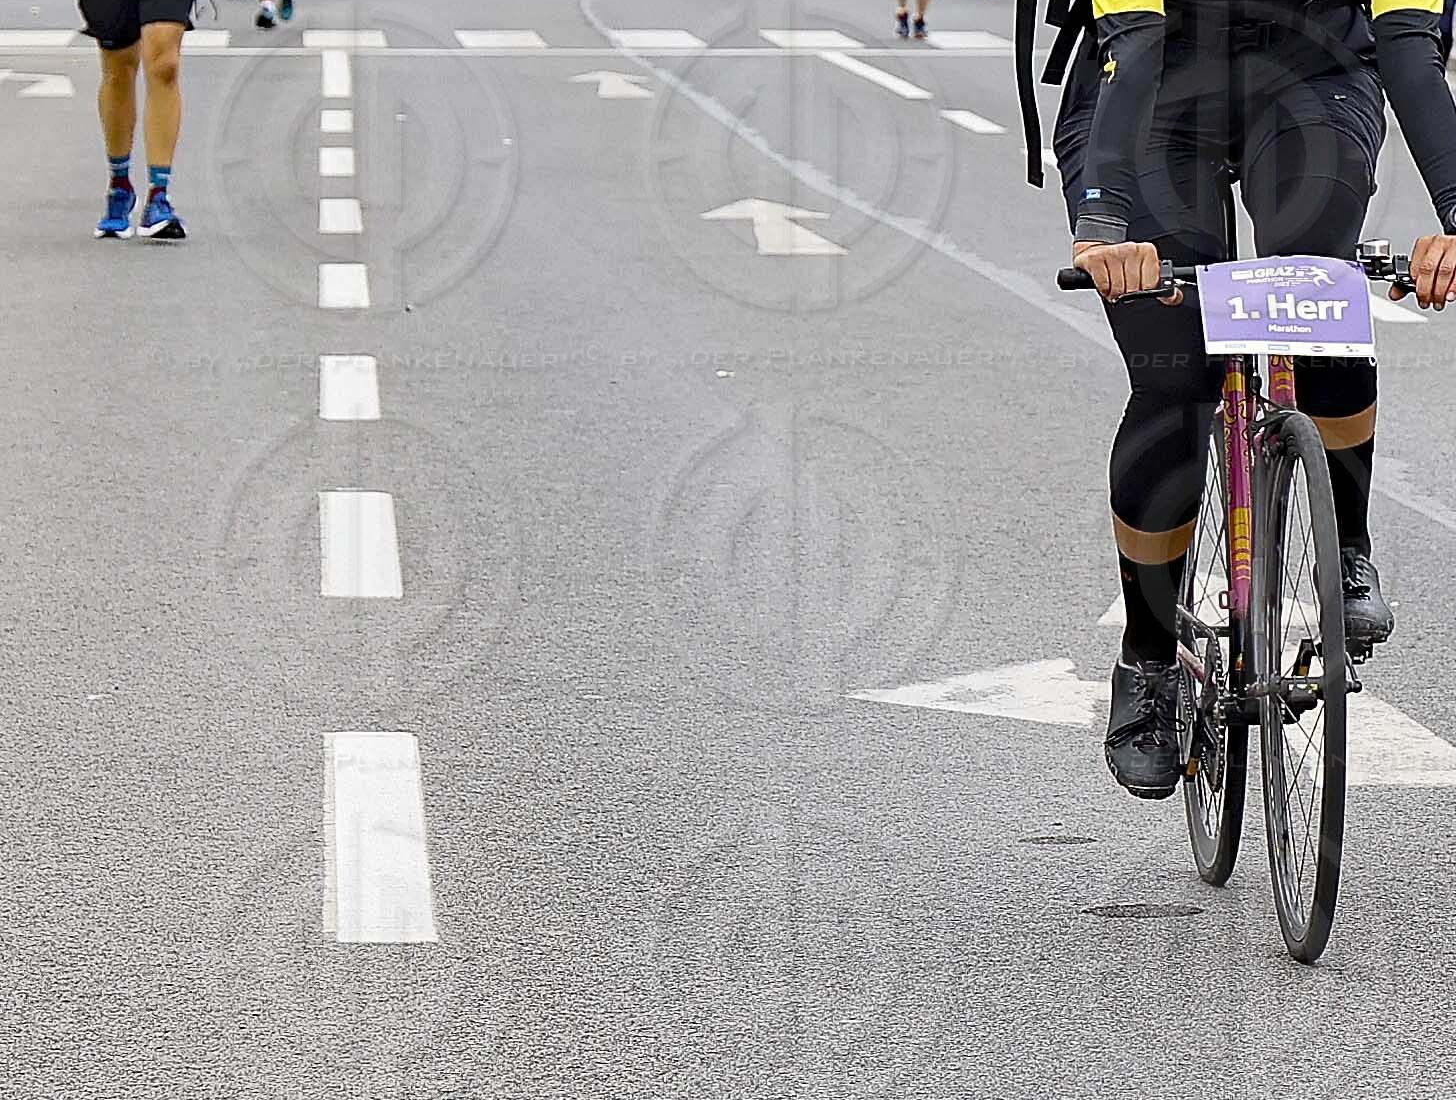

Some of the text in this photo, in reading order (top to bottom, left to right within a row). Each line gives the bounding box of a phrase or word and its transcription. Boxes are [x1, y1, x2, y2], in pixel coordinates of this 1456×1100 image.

[1255, 266, 1296, 279] GRAZ
[1227, 292, 1349, 320] 1. Herr
[1268, 324, 1312, 334] Marathon
